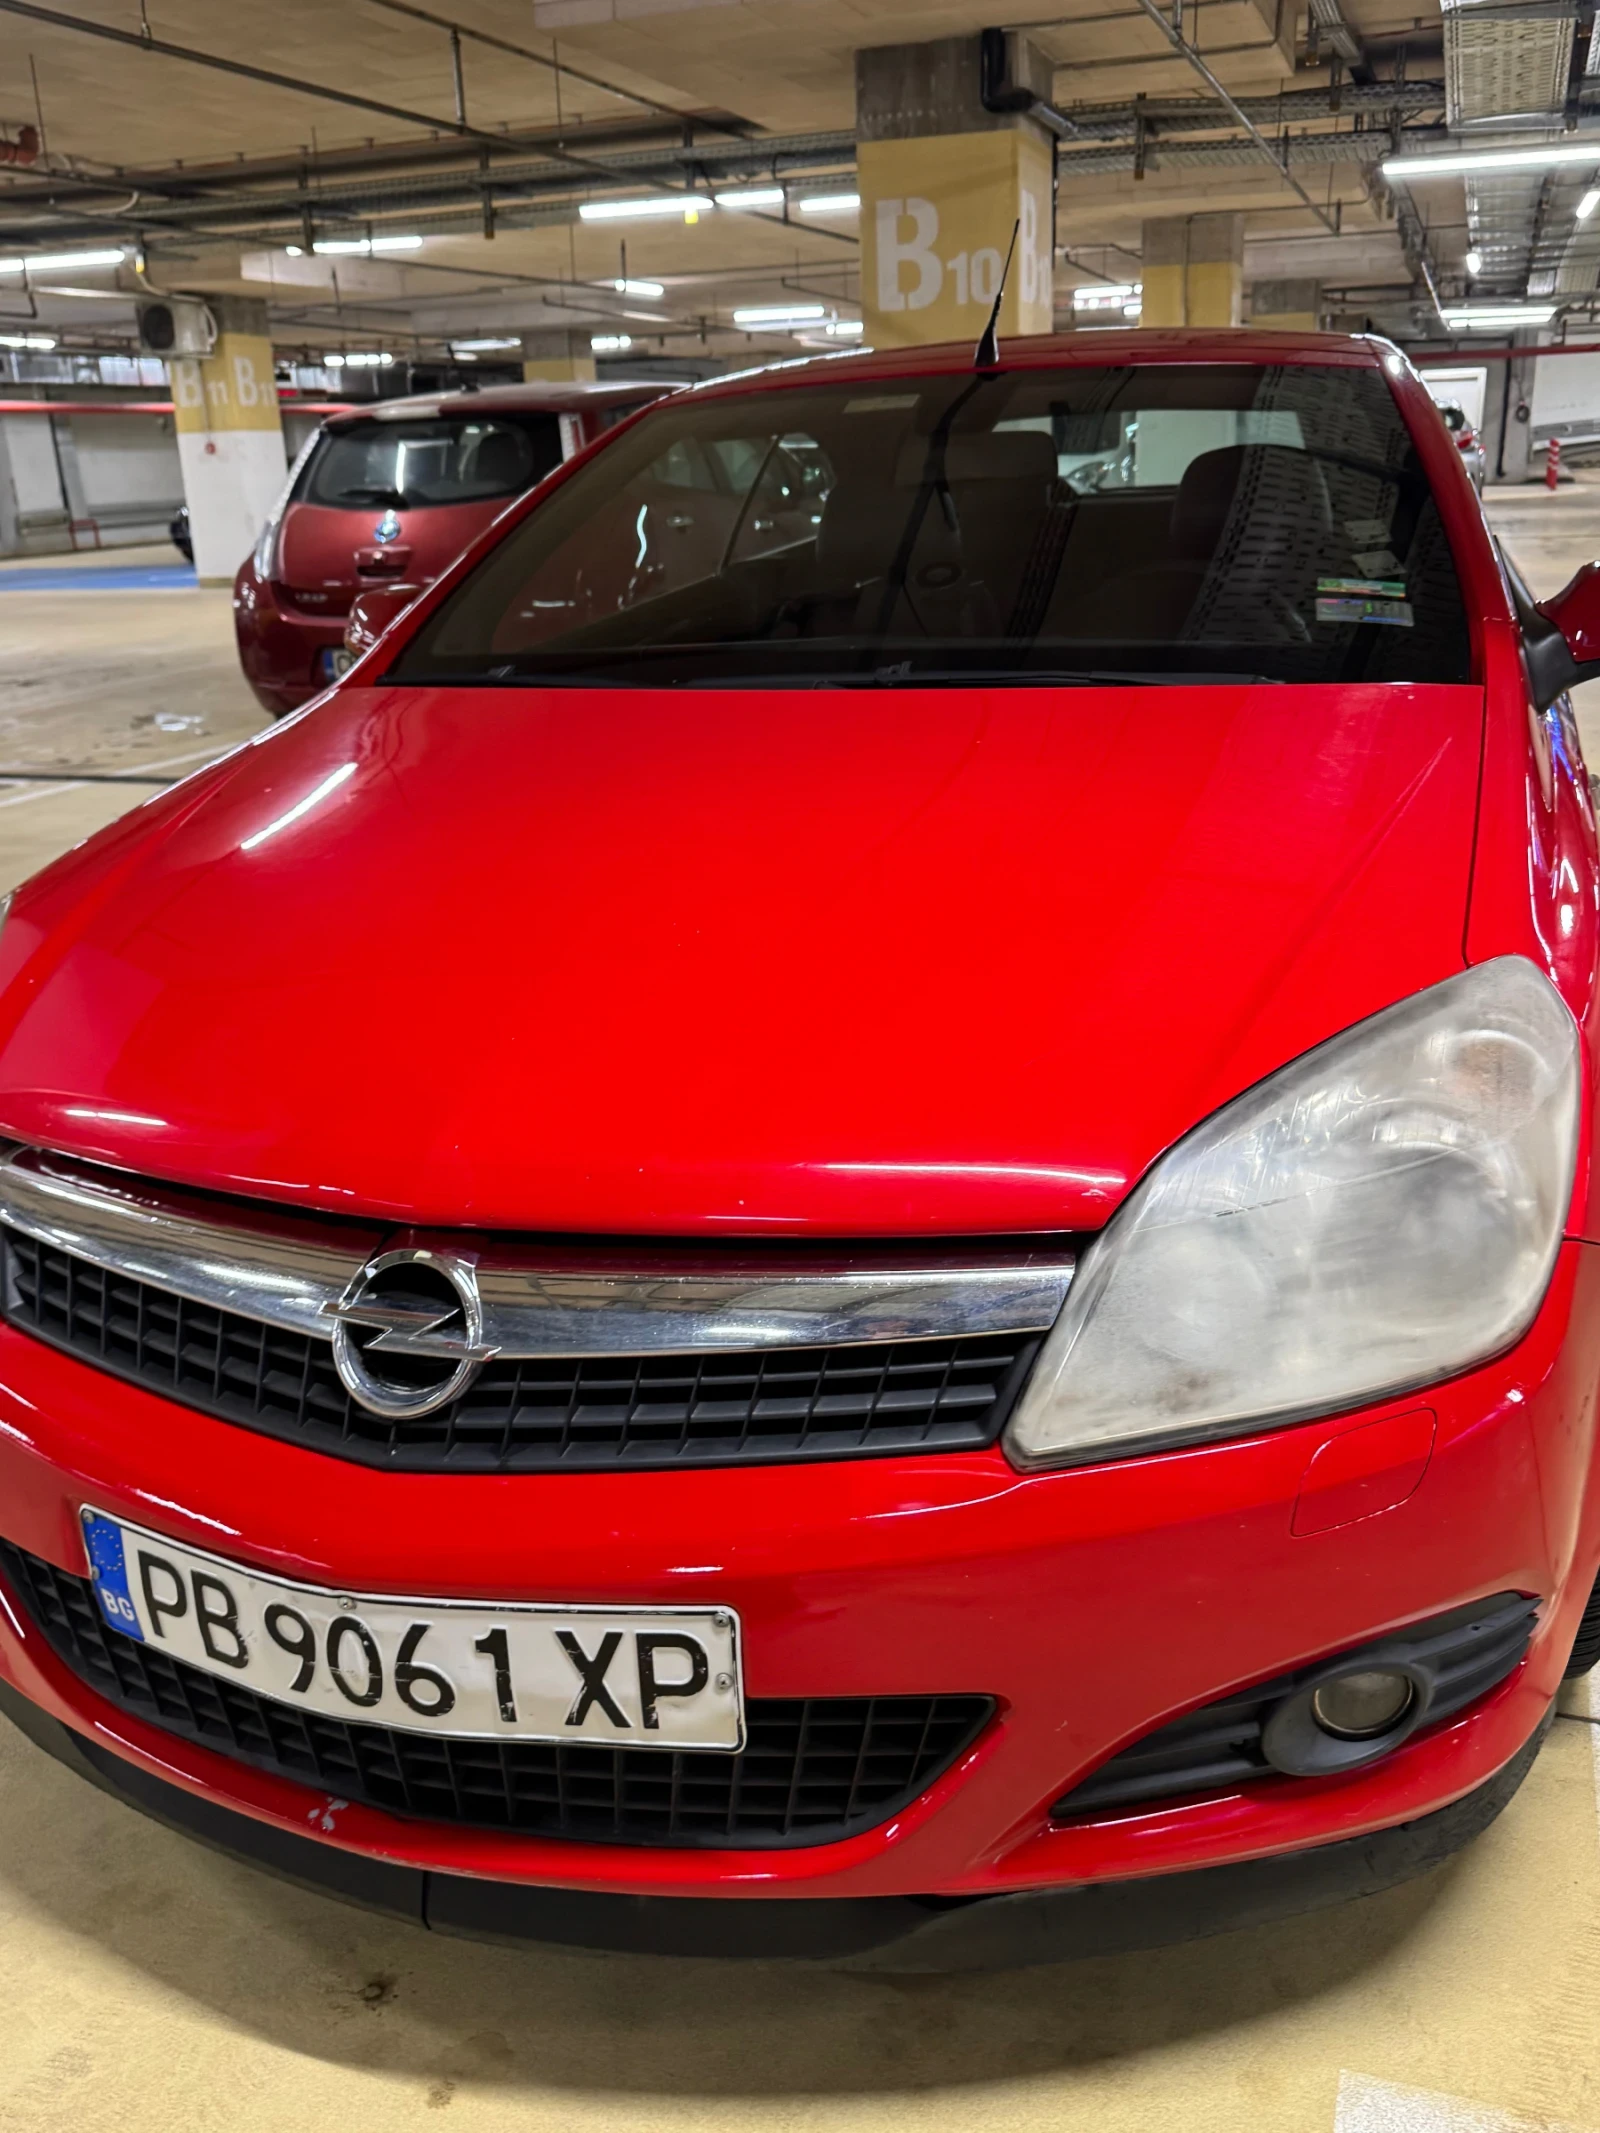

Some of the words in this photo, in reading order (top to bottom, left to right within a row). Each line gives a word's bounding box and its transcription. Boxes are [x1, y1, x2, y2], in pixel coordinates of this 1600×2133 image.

[875, 196, 1003, 312] B10
[100, 1587, 135, 1622] BG
[137, 1548, 249, 1669] PB
[263, 1602, 518, 1723] 9061
[554, 1629, 710, 1730] XP
